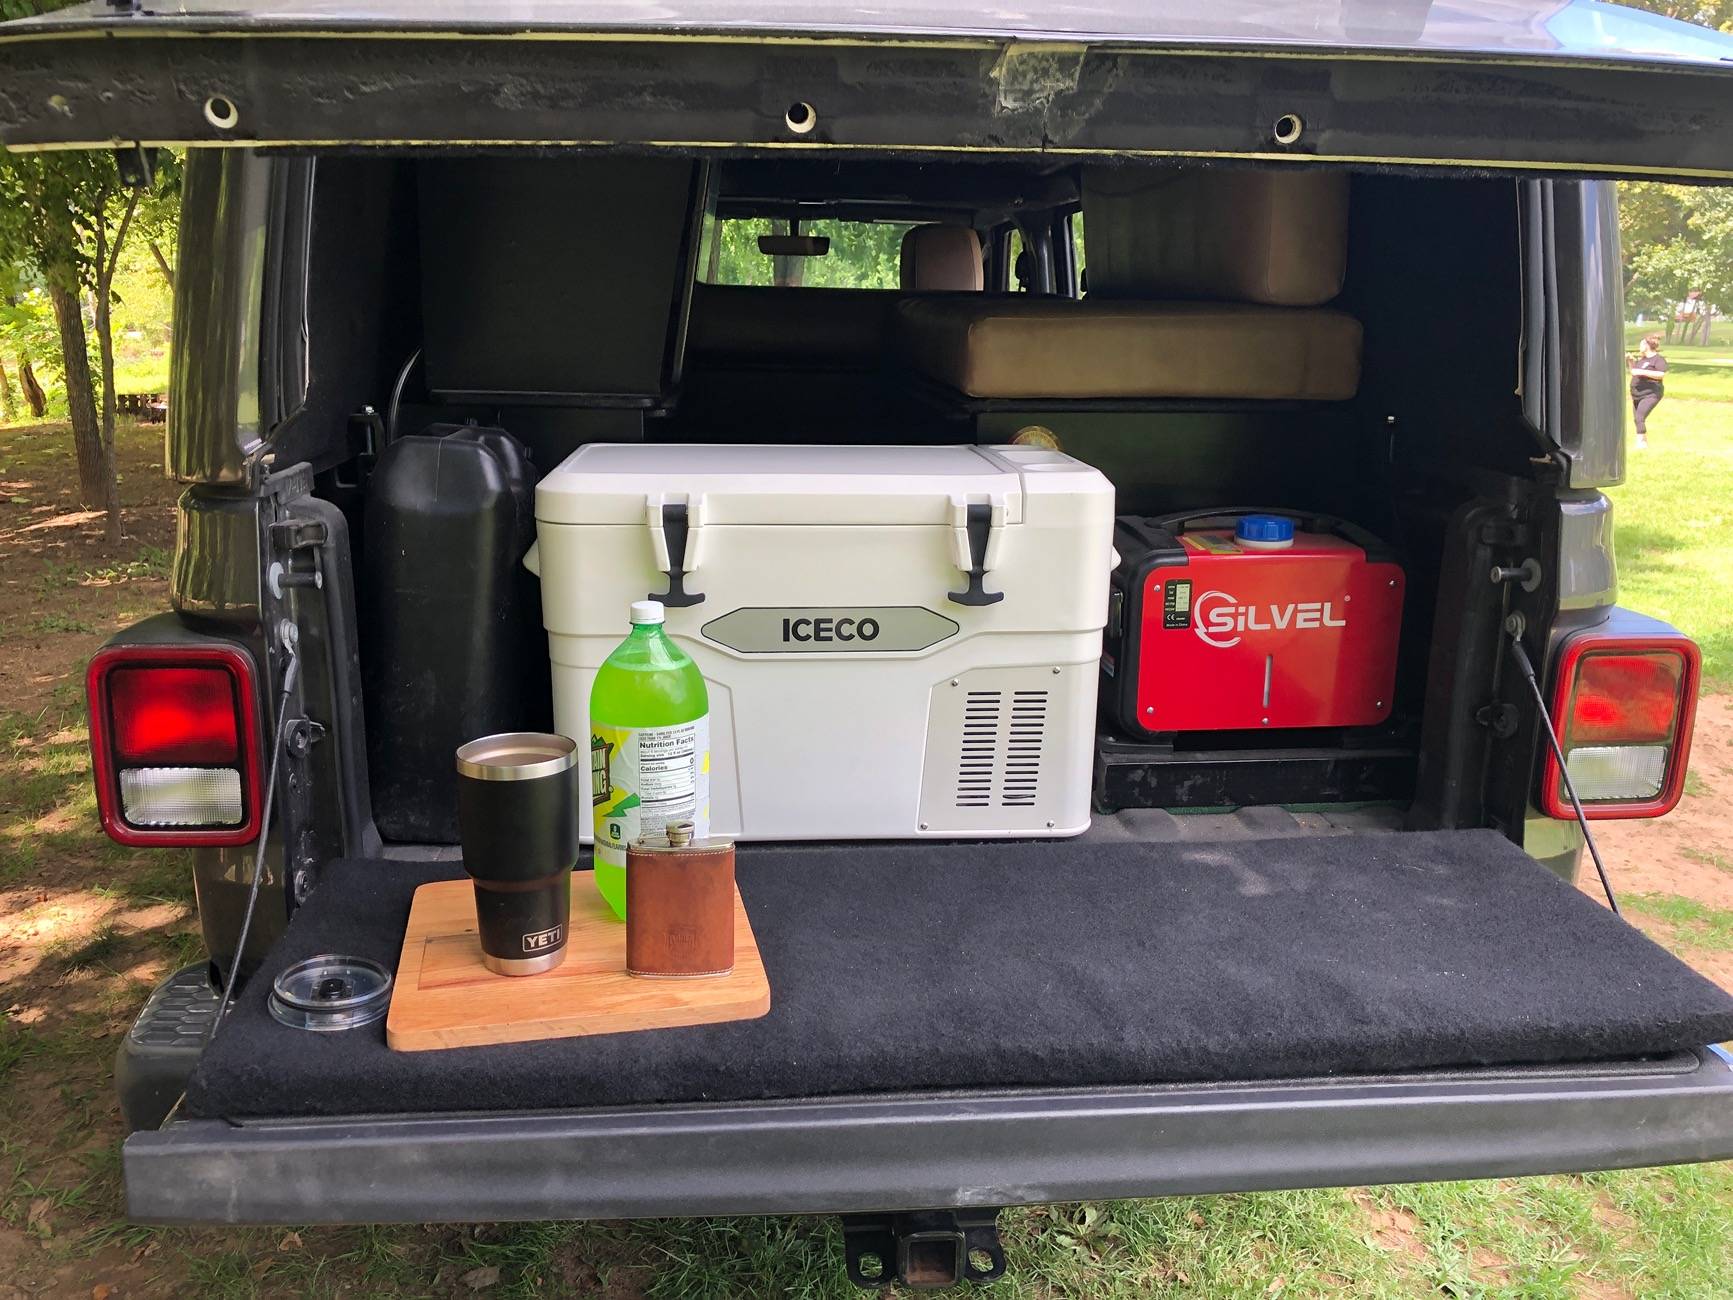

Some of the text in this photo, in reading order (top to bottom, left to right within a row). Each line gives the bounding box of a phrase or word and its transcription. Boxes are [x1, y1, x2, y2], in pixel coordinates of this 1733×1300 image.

[782, 618, 880, 642] ICECO
[640, 736, 694, 749] Nutrition Facts
[640, 764, 668, 772] Calories
[526, 928, 560, 948] YETI
